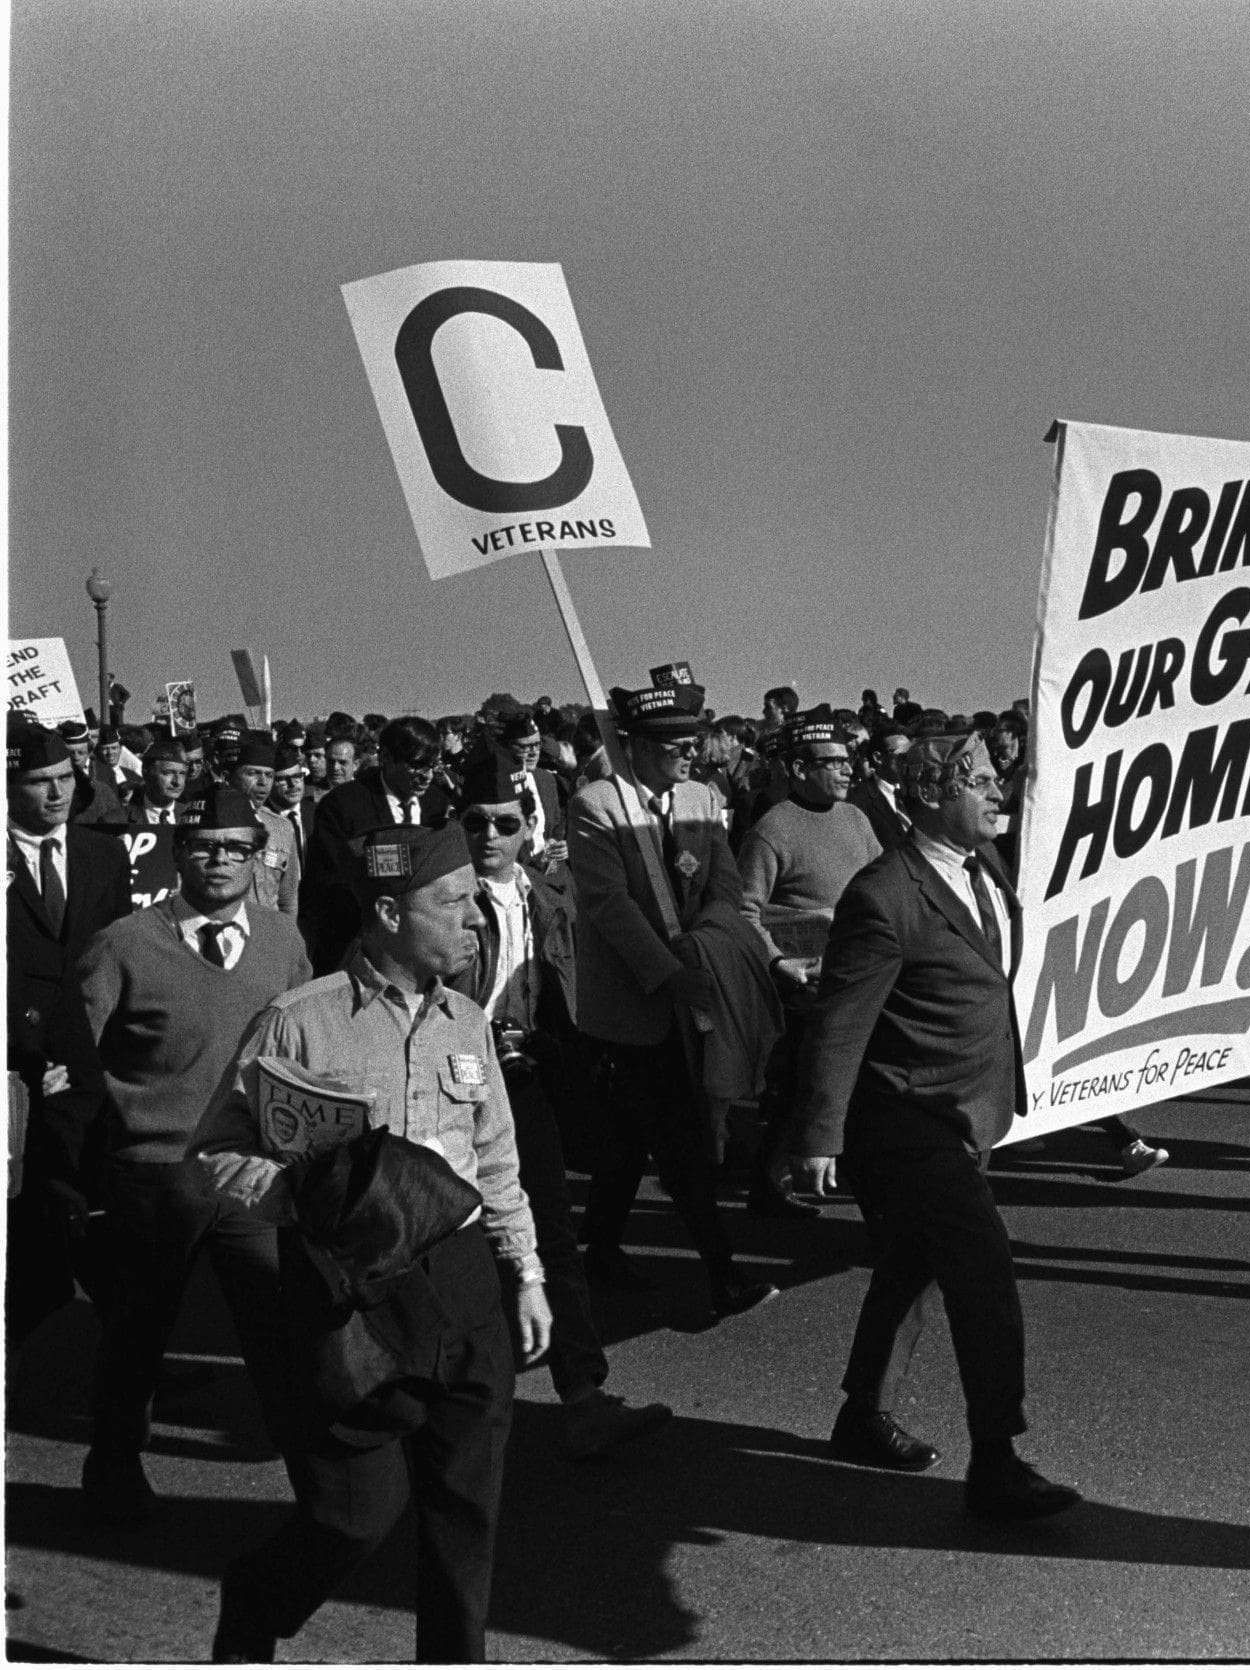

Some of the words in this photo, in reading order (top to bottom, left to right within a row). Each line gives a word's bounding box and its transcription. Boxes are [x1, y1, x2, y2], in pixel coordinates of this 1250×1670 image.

[394, 286, 594, 513] C
[471, 518, 616, 556] VETERANS
[7, 665, 46, 687] THE
[654, 690, 676, 699] PEACE
[1061, 637, 1186, 749] OUR
[640, 699, 674, 712] VIETNAM
[802, 732, 831, 740] VIETNAM
[1050, 1070, 1133, 1106] VETERANS
[1170, 1047, 1232, 1085] PEACE
[268, 1083, 356, 1126] TIME
